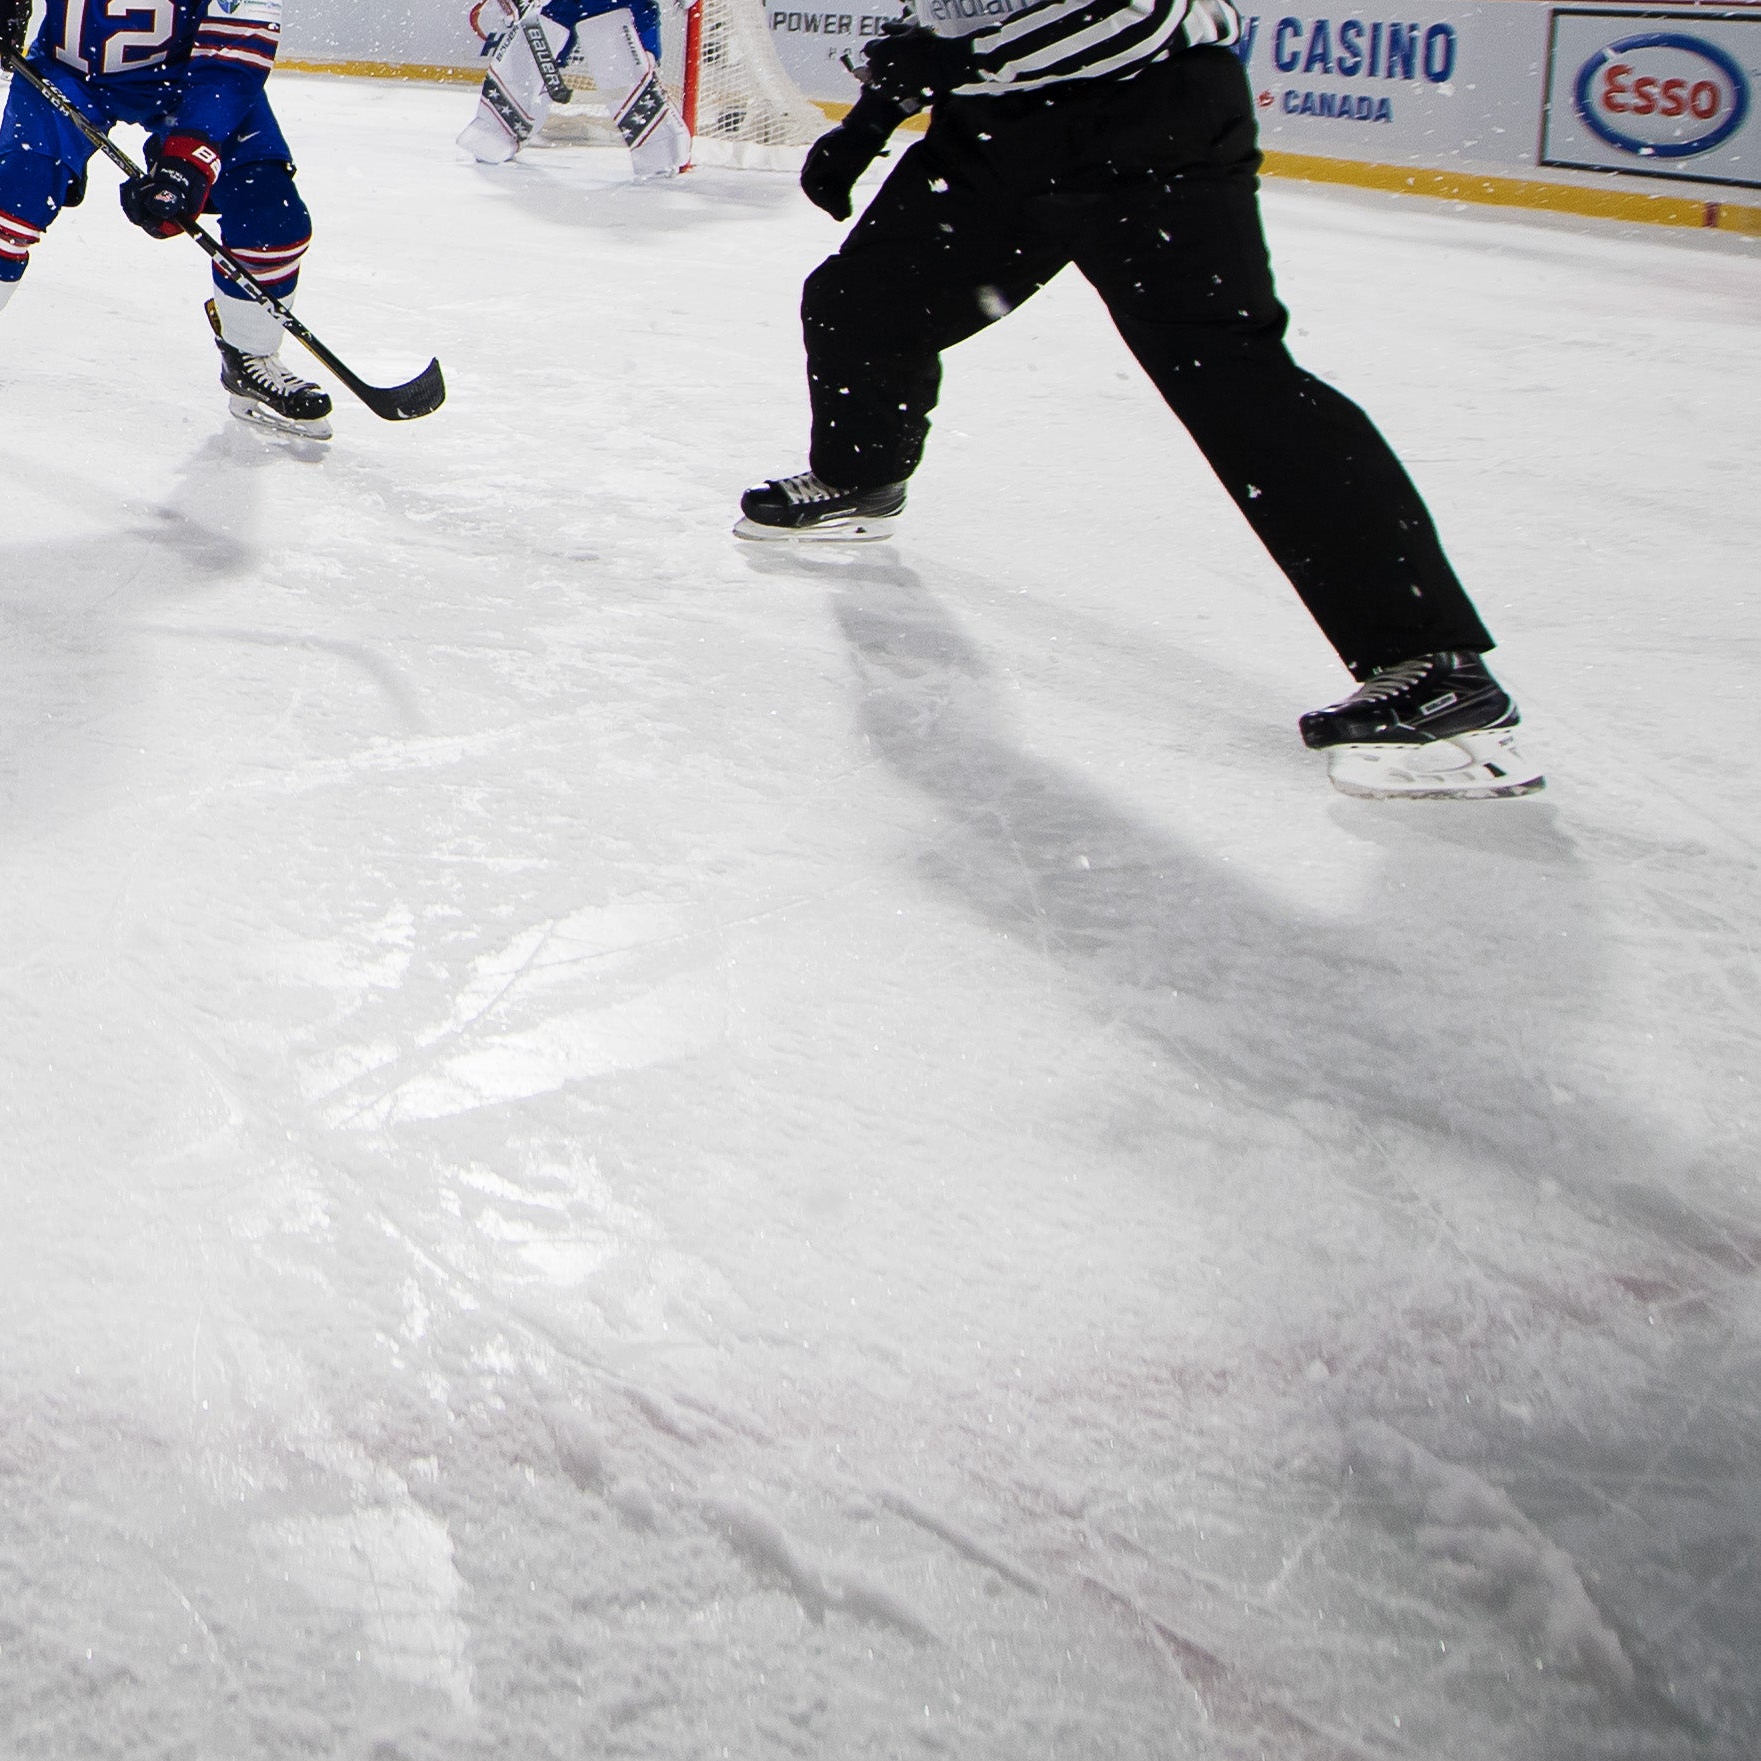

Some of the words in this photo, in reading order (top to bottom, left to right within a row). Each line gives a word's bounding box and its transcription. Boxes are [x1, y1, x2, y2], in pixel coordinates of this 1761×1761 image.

[773, 11, 853, 35] POWER
[1273, 14, 1458, 85] CASINO
[528, 26, 561, 90] BAUER
[1283, 89, 1394, 124] CANADA
[1601, 62, 1723, 121] Esso
[212, 249, 294, 325] CCM
